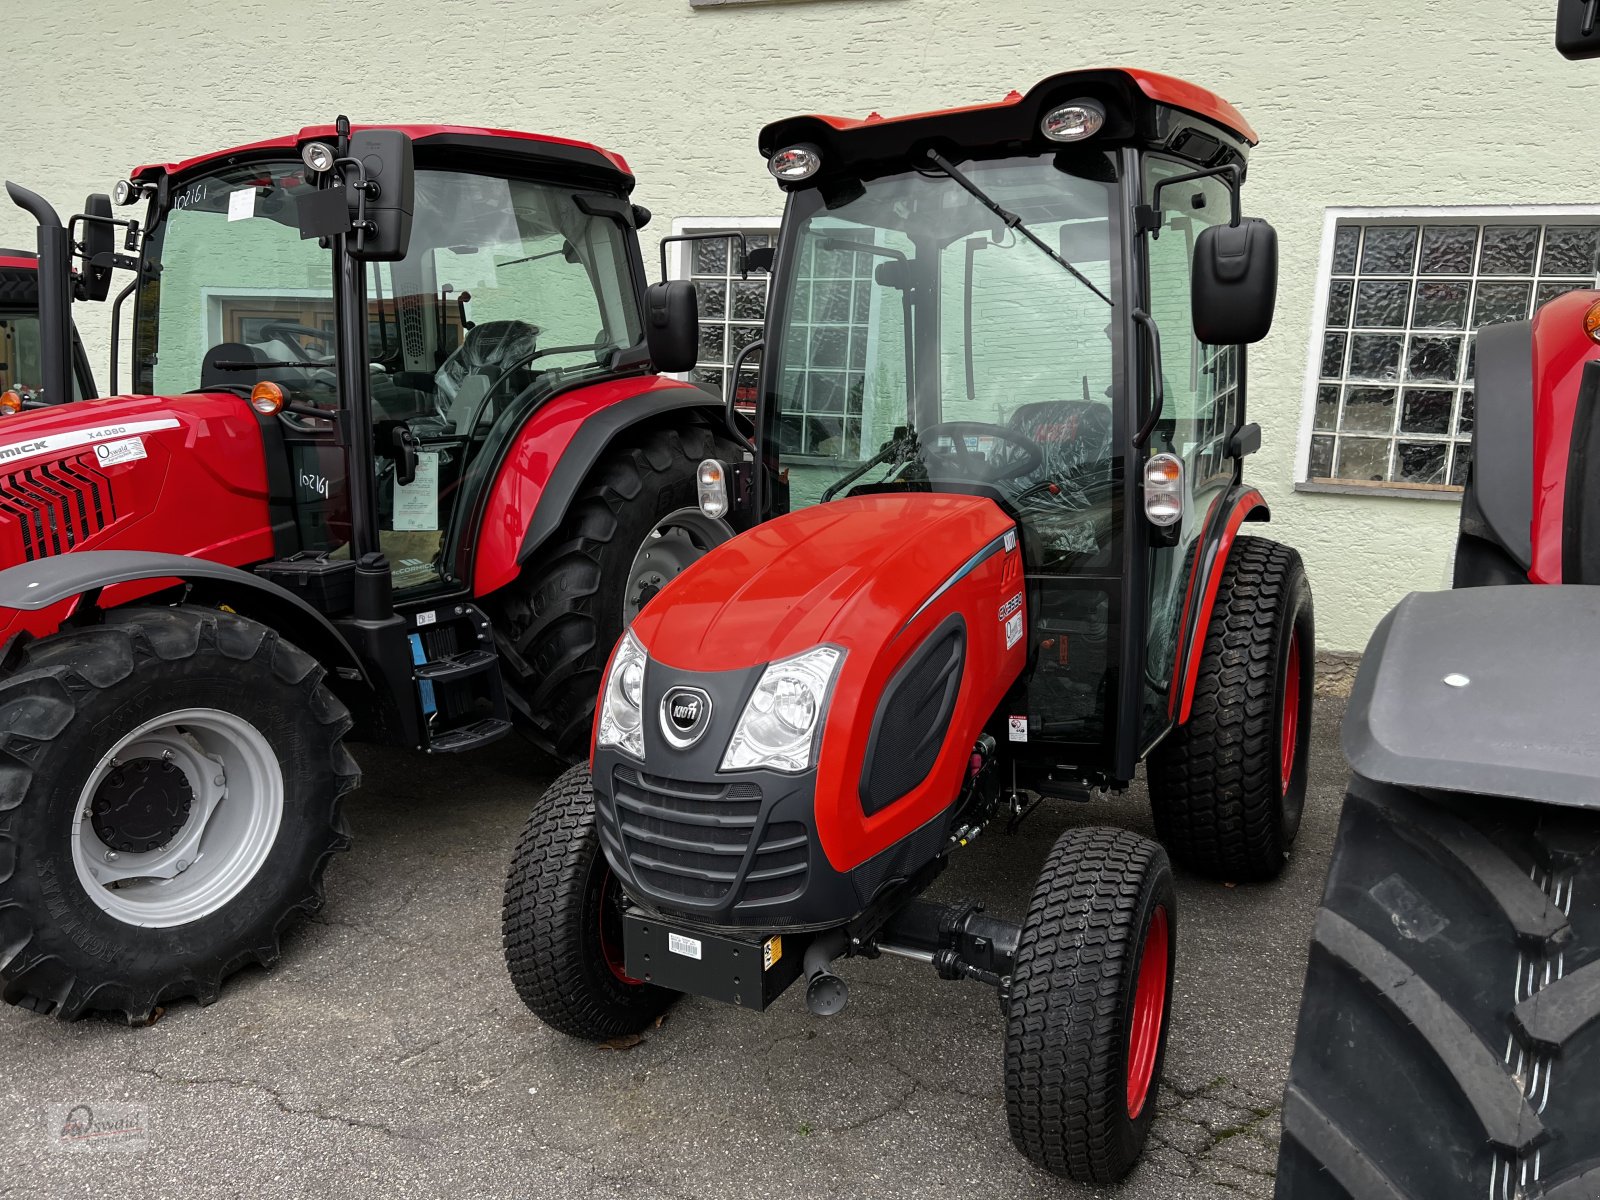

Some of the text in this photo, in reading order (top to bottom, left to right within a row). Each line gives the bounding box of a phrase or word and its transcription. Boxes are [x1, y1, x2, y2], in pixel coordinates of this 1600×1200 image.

[174, 185, 207, 210] 102161
[88, 427, 126, 439] X4.080
[97, 445, 128, 458] Oswald
[299, 468, 329, 499] 102161
